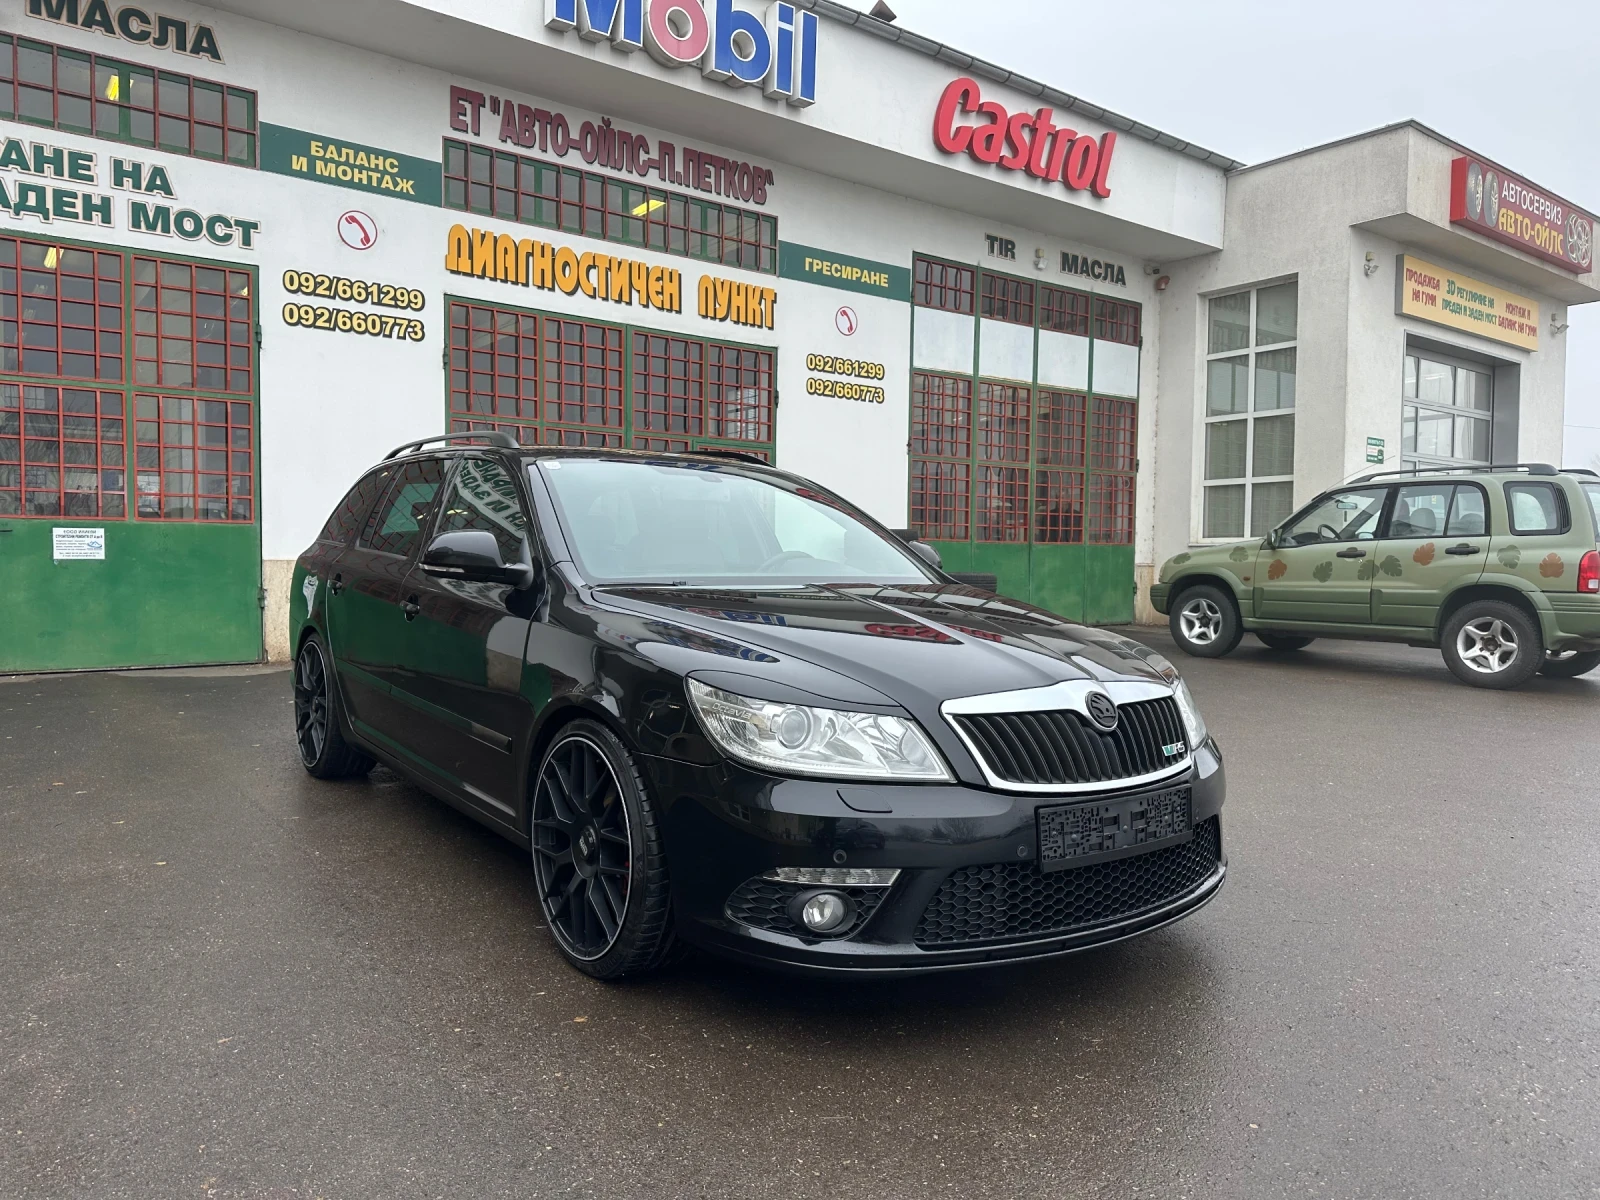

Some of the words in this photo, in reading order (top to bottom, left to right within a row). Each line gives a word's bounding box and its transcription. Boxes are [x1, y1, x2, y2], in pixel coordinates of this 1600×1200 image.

[450, 85, 485, 135] ЕТ
[933, 77, 1117, 198] Castrol
[310, 141, 399, 173] БАЛАНС
[113, 159, 175, 196] НА
[292, 156, 307, 172] И
[315, 163, 415, 195] МОНТАЖ
[1502, 180, 1562, 225] АВТОСЕРВИЗ
[131, 202, 259, 248] МОСТ
[1499, 207, 1563, 256] АВТО-ОЙЛС
[985, 233, 1016, 260] TIR
[446, 224, 682, 313] ДИАГНОСТИЧЕН
[698, 274, 777, 329] ПУНКТ
[804, 257, 889, 287] ГРЕСИРАНЕ
[1060, 251, 1127, 286] МАСЛА
[1405, 267, 1440, 291] ПРОДАЖБА
[283, 270, 425, 311] 092/661299
[1412, 288, 1420, 302] НА
[1446, 279, 1456, 296] 3D
[283, 303, 425, 341] 092/660773
[807, 353, 885, 381] 092/661299
[807, 377, 885, 404] 092/660773
[712, 702, 753, 720] Octavia
